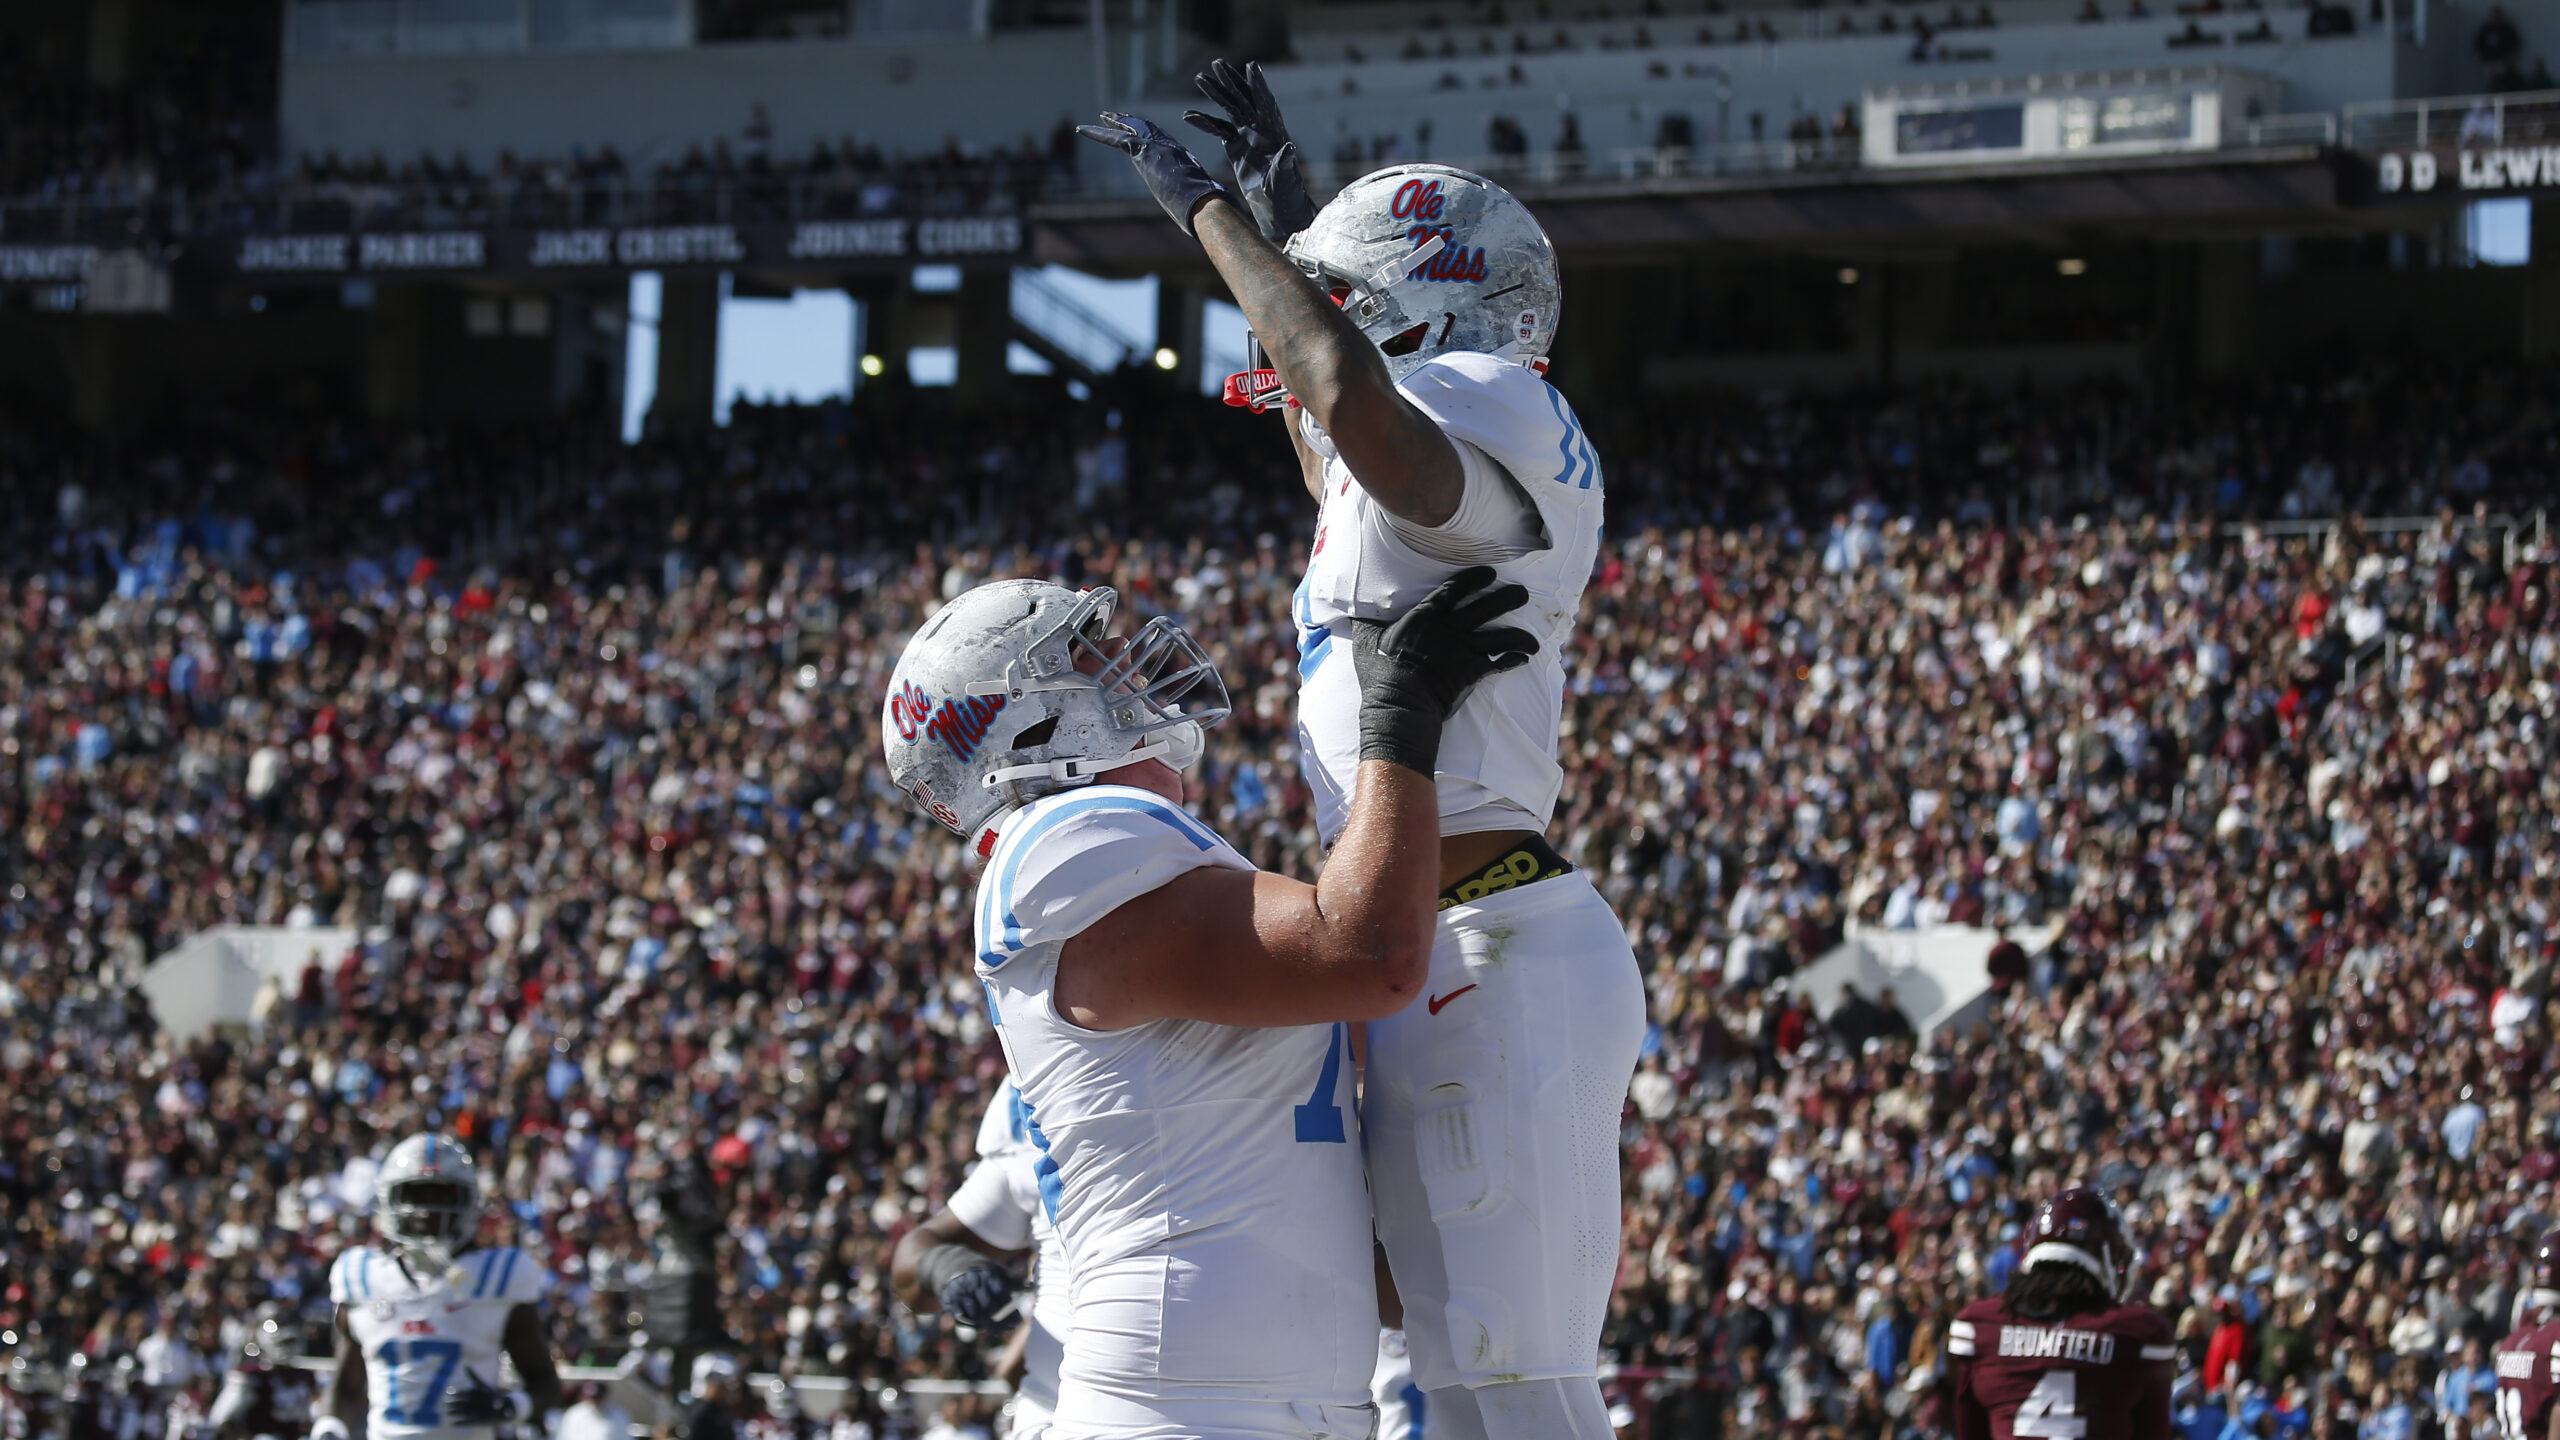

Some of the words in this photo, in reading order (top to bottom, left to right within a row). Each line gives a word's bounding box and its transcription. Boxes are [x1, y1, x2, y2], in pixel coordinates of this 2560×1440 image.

[2411, 151, 2438, 192] D
[2459, 147, 2560, 190] LEWI
[1389, 178, 1447, 223] Ole
[360, 232, 485, 269] PARKER
[530, 230, 611, 266] JACK
[1405, 223, 1489, 286] Miss
[891, 678, 932, 745] Ole
[926, 693, 1007, 764] Miss
[1456, 850, 1540, 905] PSD
[1998, 1324, 2116, 1366] BRUMFIELD
[376, 1340, 461, 1427] 17
[2012, 1370, 2087, 1440] 4
